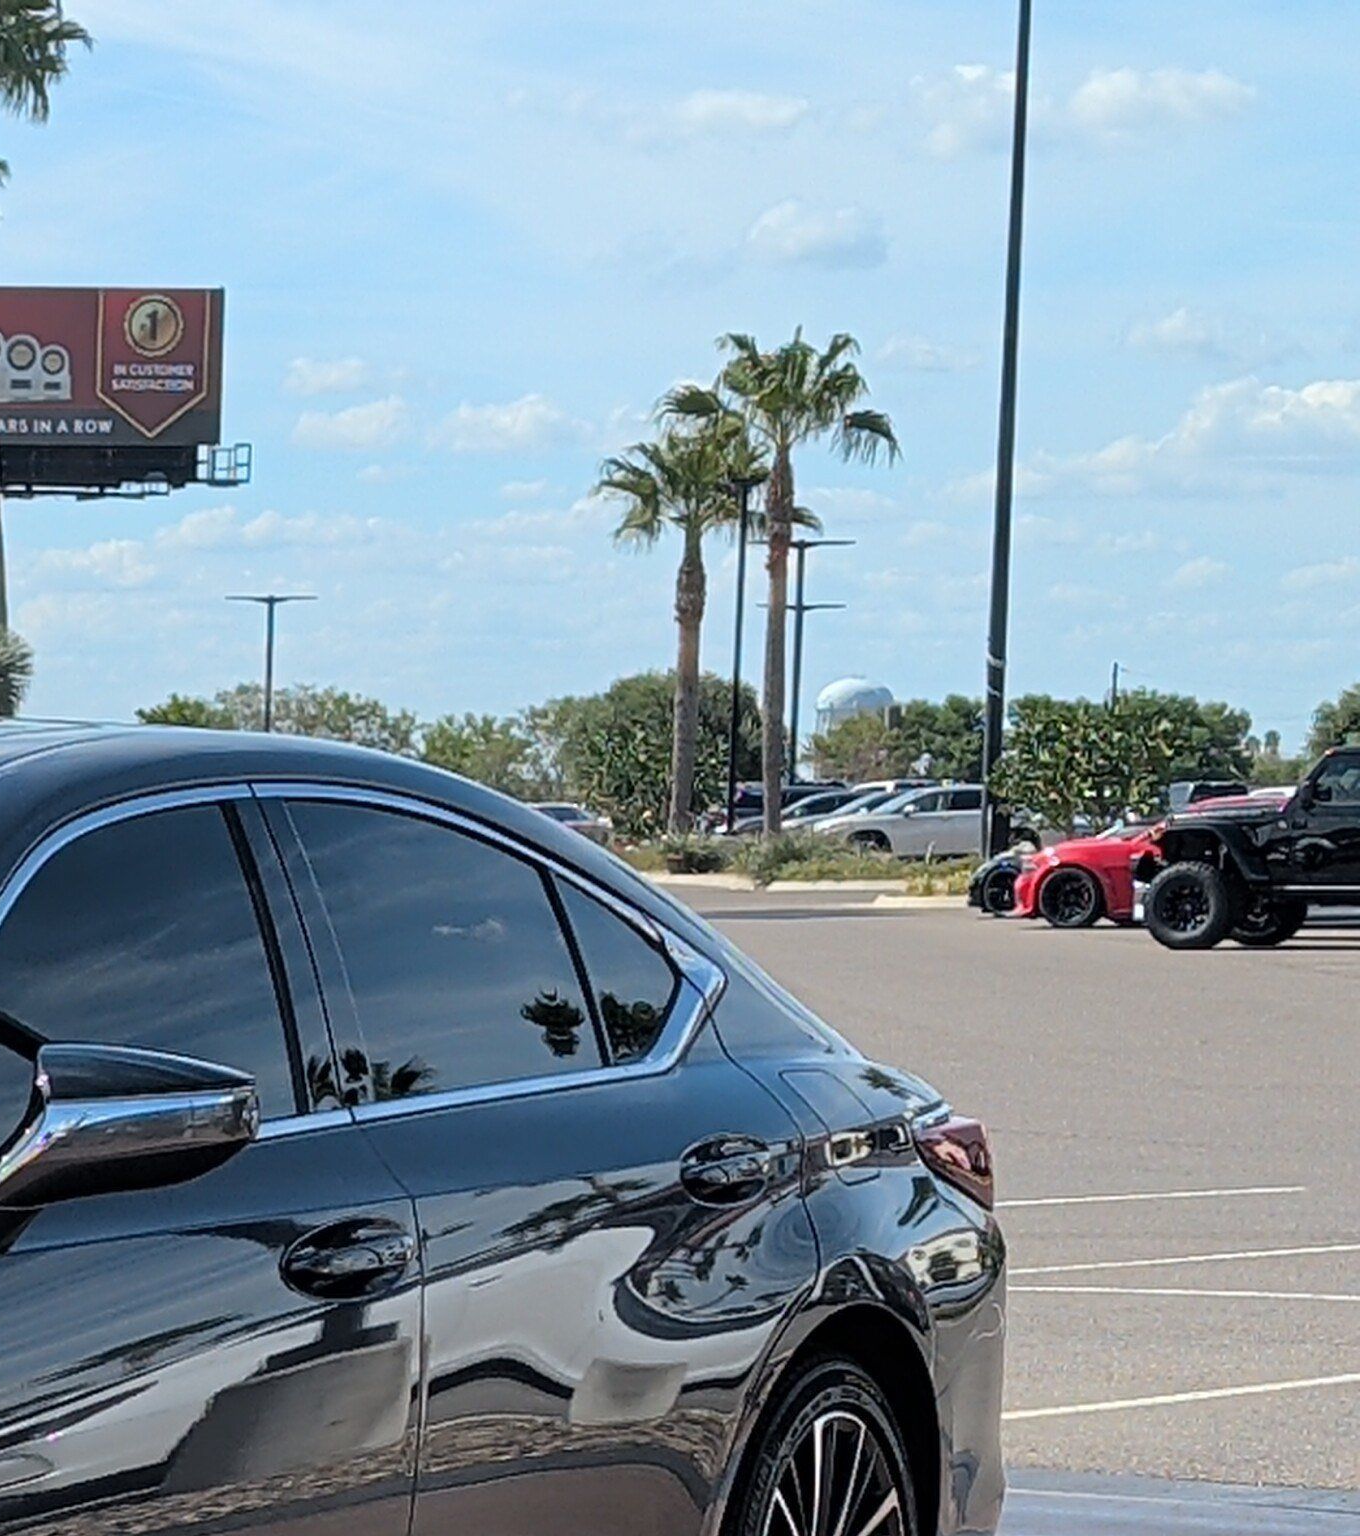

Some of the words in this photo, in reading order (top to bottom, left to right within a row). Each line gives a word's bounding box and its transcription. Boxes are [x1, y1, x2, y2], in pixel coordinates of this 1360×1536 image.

[129, 364, 195, 376] CUSTOMER
[33, 418, 52, 433] IN
[56, 418, 69, 433] A
[73, 418, 114, 434] ROW
